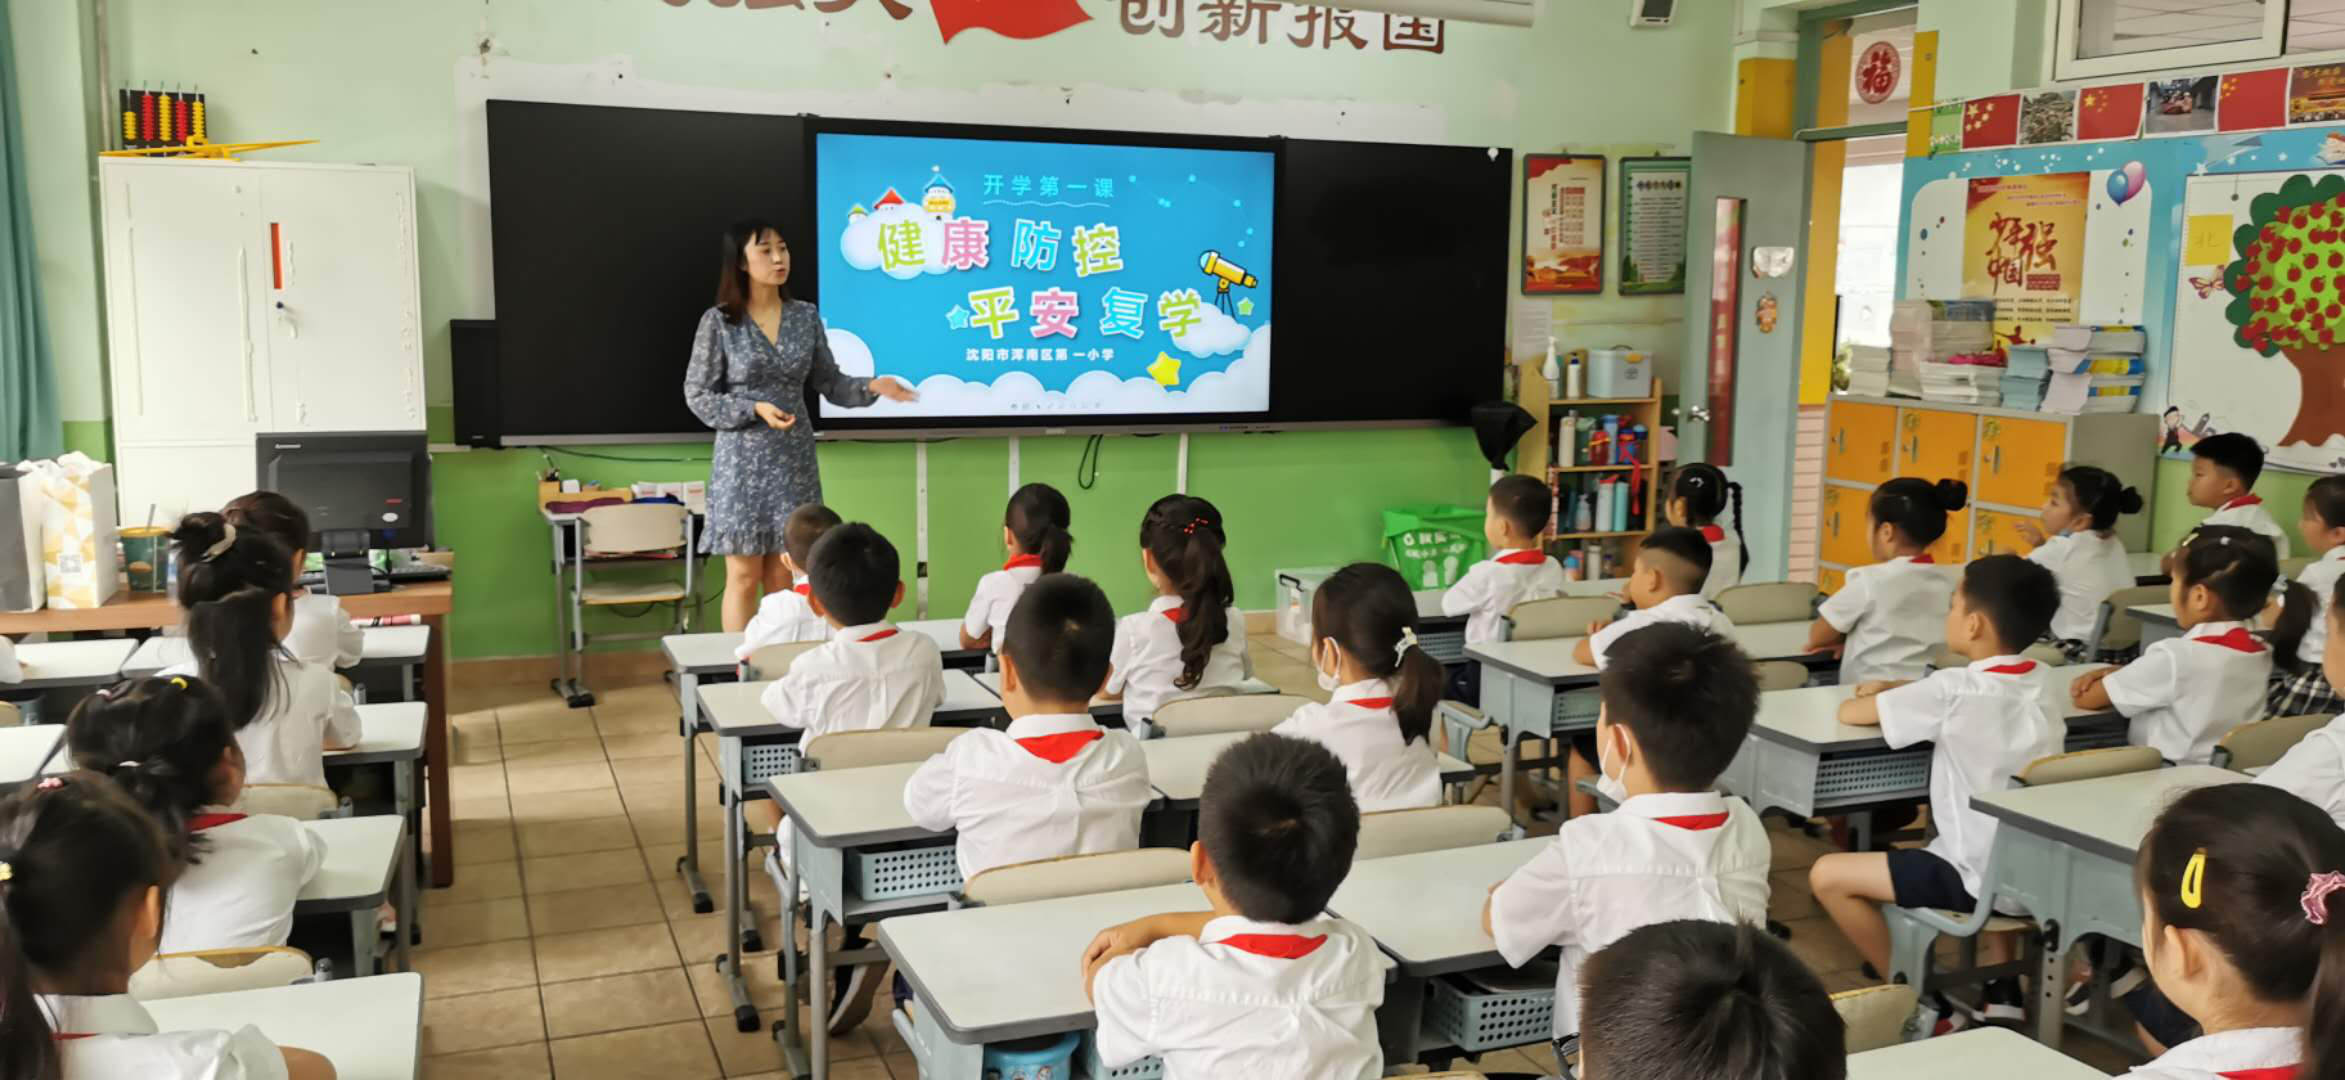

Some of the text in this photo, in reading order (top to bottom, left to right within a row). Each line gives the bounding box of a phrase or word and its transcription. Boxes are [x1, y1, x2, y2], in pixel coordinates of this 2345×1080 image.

[1120, 0, 1445, 54] 创新报国
[1862, 49, 1893, 94] 福
[983, 174, 1115, 198] 开学第一课
[877, 216, 1125, 278] 健康防控
[968, 287, 1203, 341] 平安复学
